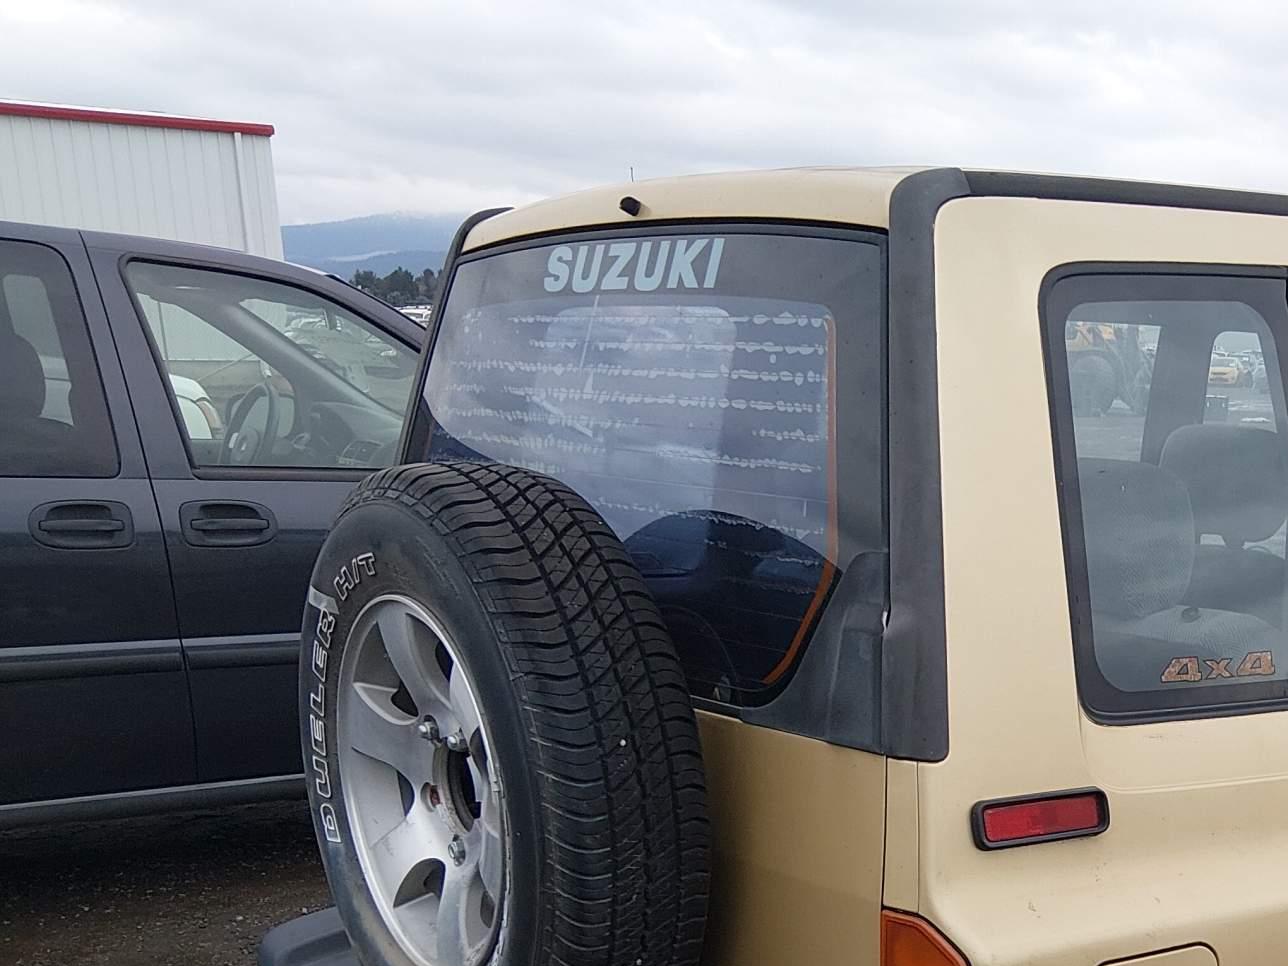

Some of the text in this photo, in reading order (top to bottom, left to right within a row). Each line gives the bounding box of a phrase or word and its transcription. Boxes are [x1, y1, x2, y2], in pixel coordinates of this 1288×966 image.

[543, 237, 726, 293] SUZUKI
[1160, 650, 1276, 683] 4x4
[309, 552, 377, 844] DUELER H/T
